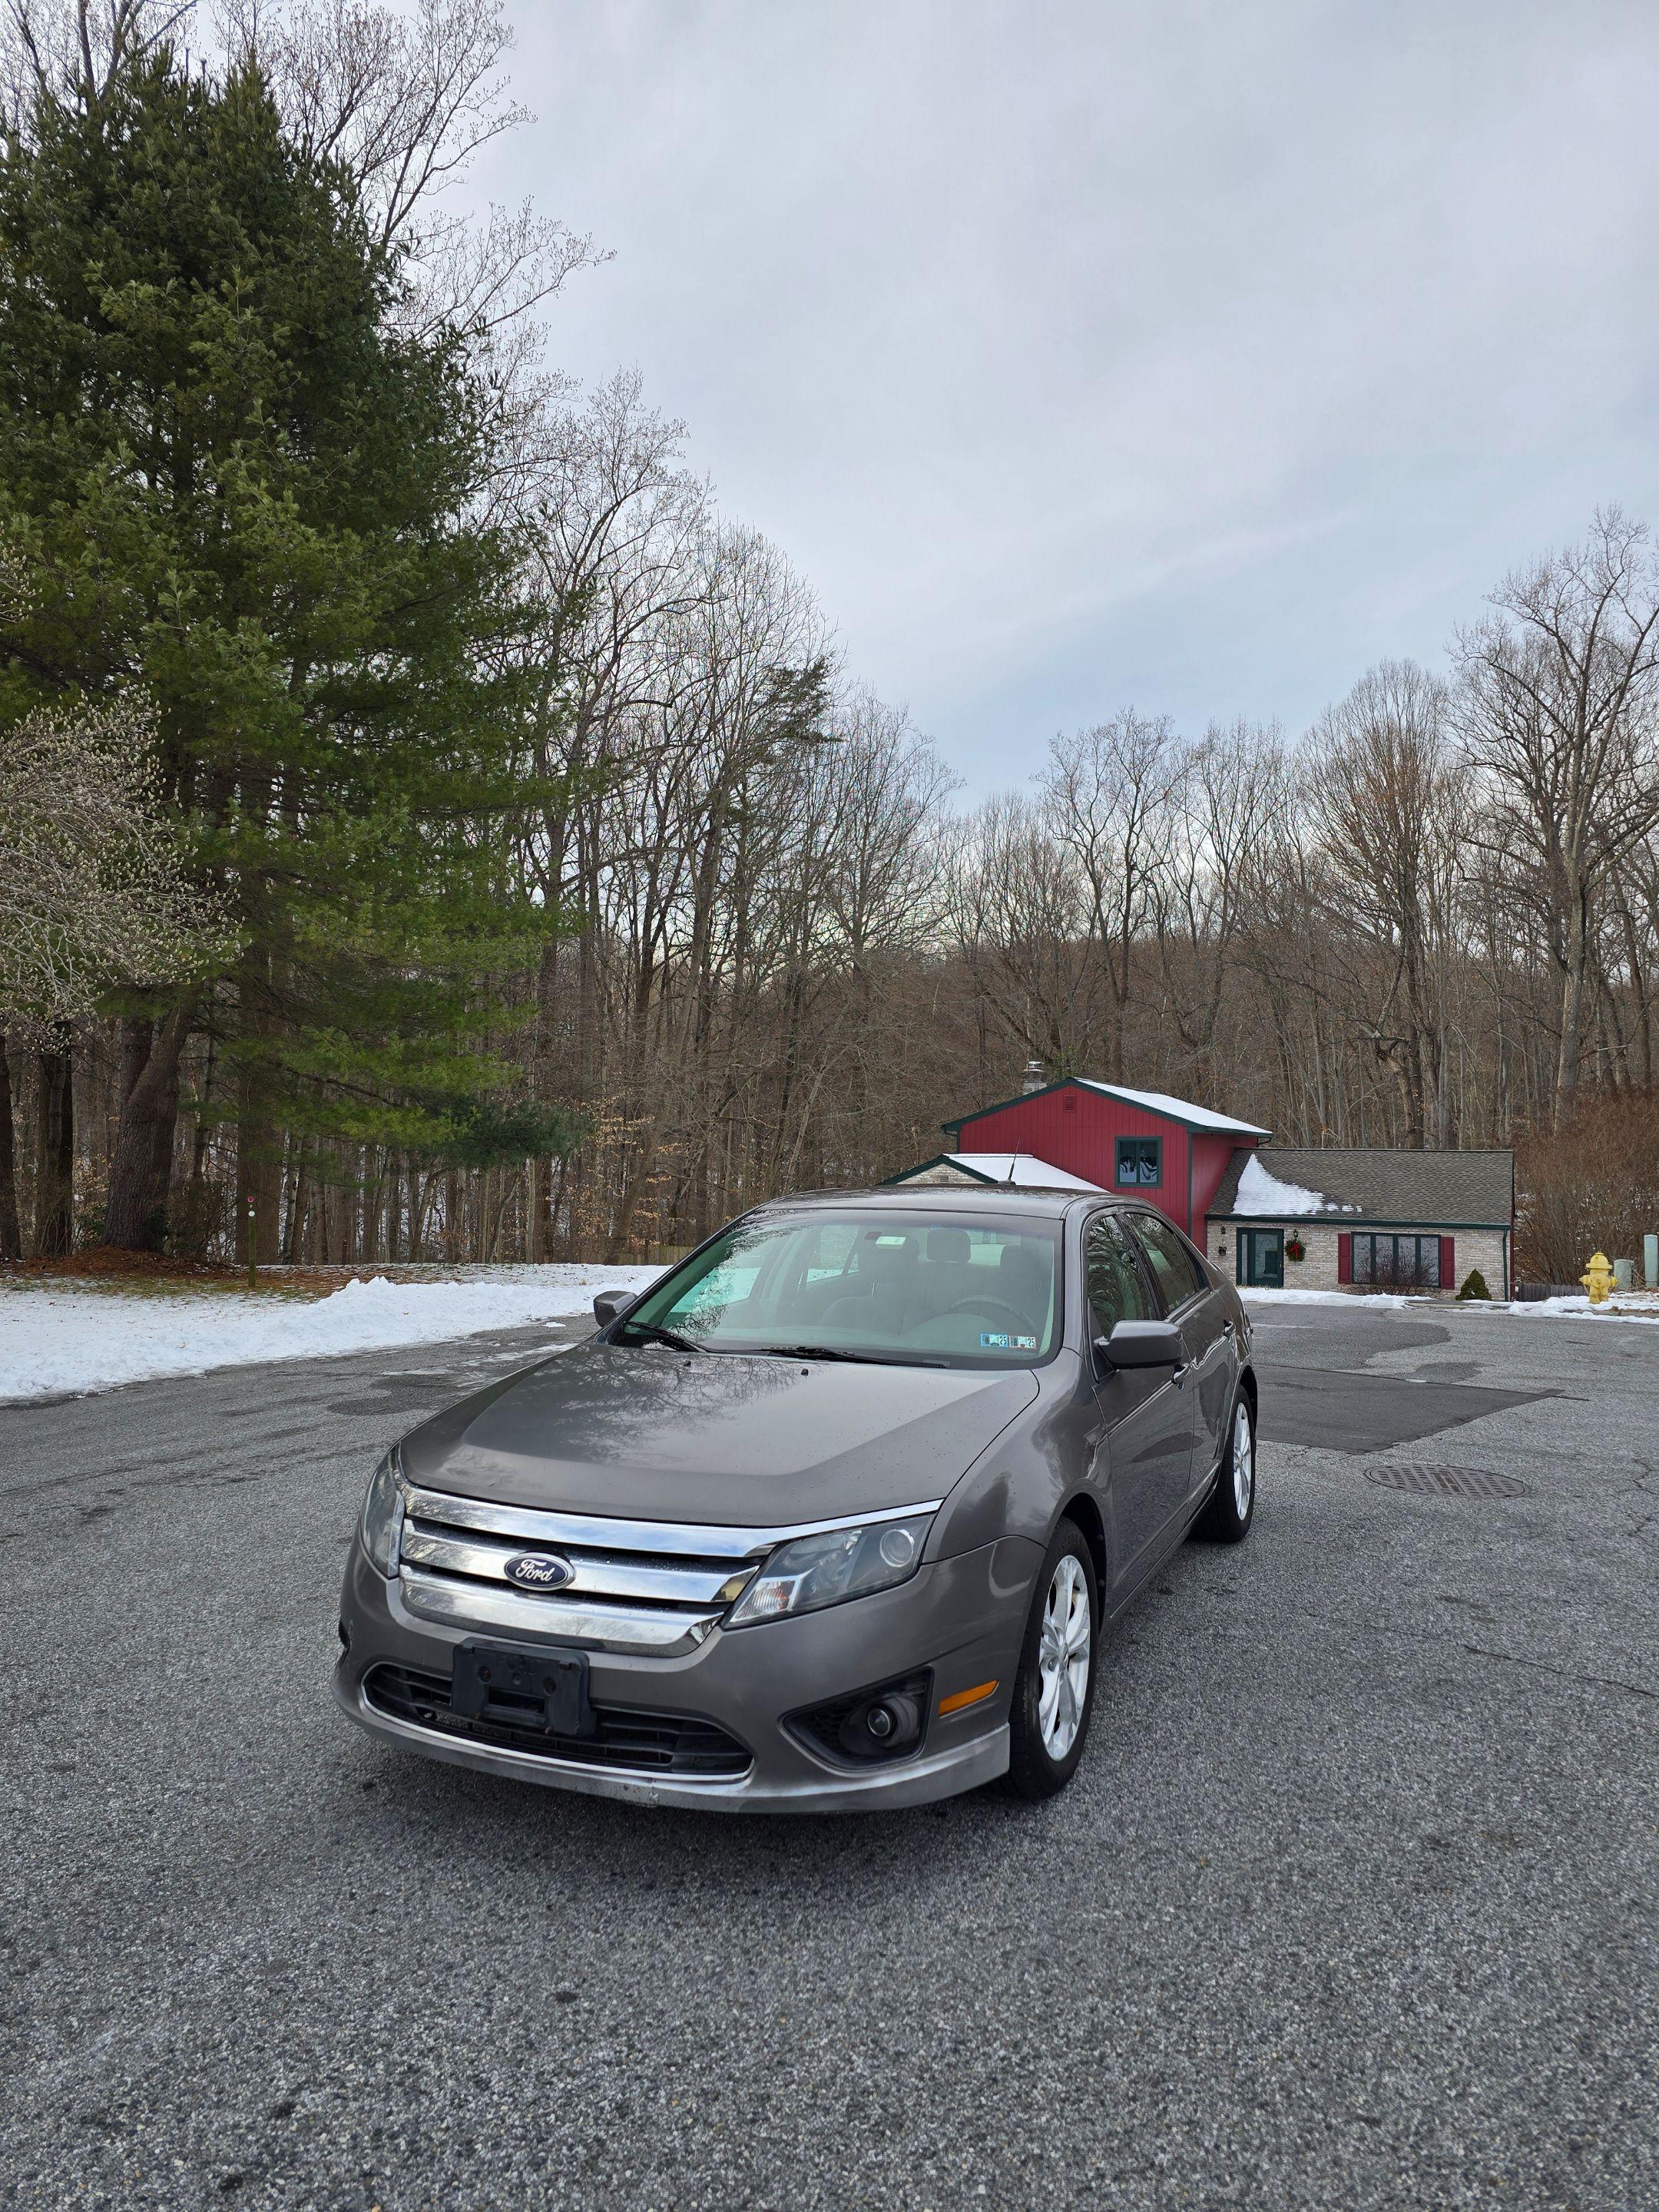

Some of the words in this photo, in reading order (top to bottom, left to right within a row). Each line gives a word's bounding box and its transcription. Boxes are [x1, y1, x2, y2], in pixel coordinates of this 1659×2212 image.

[999, 1336, 1007, 1345] 25
[1028, 1337, 1035, 1347] 25
[515, 1559, 555, 1582] Ford
